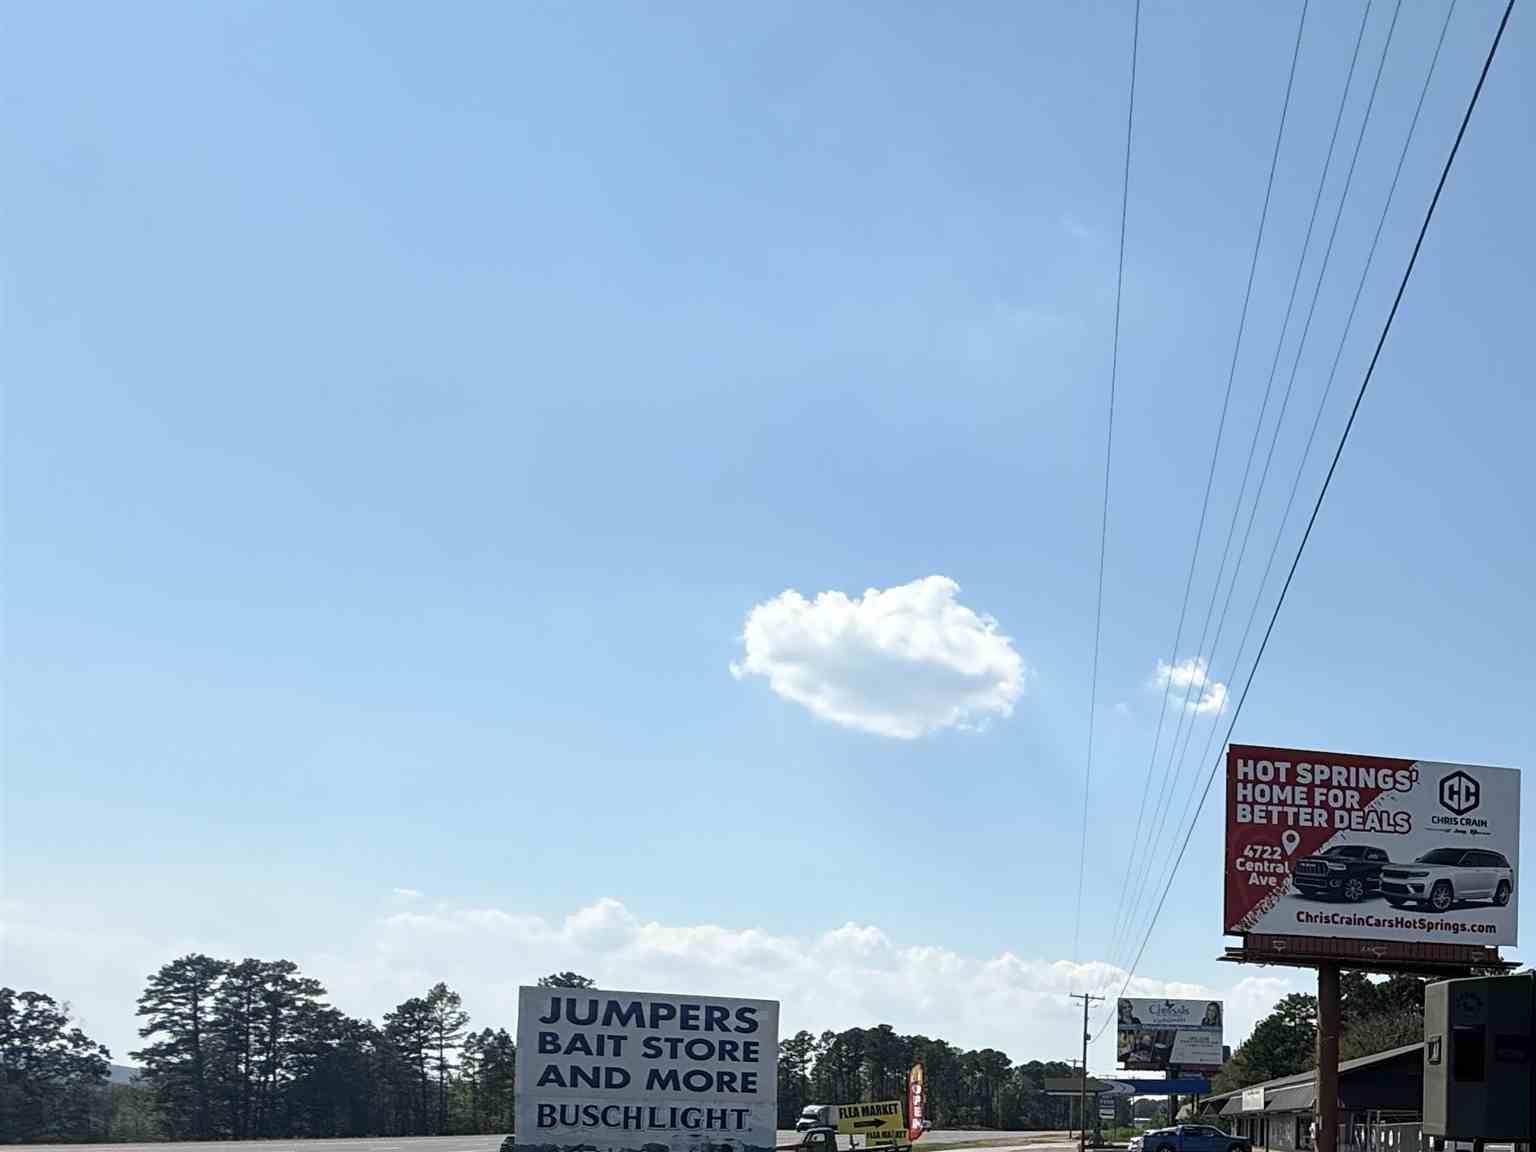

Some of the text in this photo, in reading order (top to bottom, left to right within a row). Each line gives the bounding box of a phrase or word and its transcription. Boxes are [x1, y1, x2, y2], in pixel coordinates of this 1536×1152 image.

[1236, 759, 1291, 783] HOT
[1236, 782, 1361, 809] HOME FOR
[1236, 804, 1412, 834] BETTER DEALS
[1431, 815, 1488, 828] CHRIS CRAIN
[1243, 844, 1282, 860] 4722
[1235, 857, 1290, 874] Central
[1248, 872, 1278, 887] Ave
[1296, 911, 1497, 935] ChrisCrainCarsHotSprings.com
[538, 996, 760, 1034] JUMPERS
[537, 1031, 760, 1064] BAIT STORE
[536, 1064, 758, 1095] AND MORE
[536, 1103, 642, 1130] BUSCH
[838, 1103, 898, 1120] FLEA MARKET
[911, 1084, 923, 1130] OPEN
